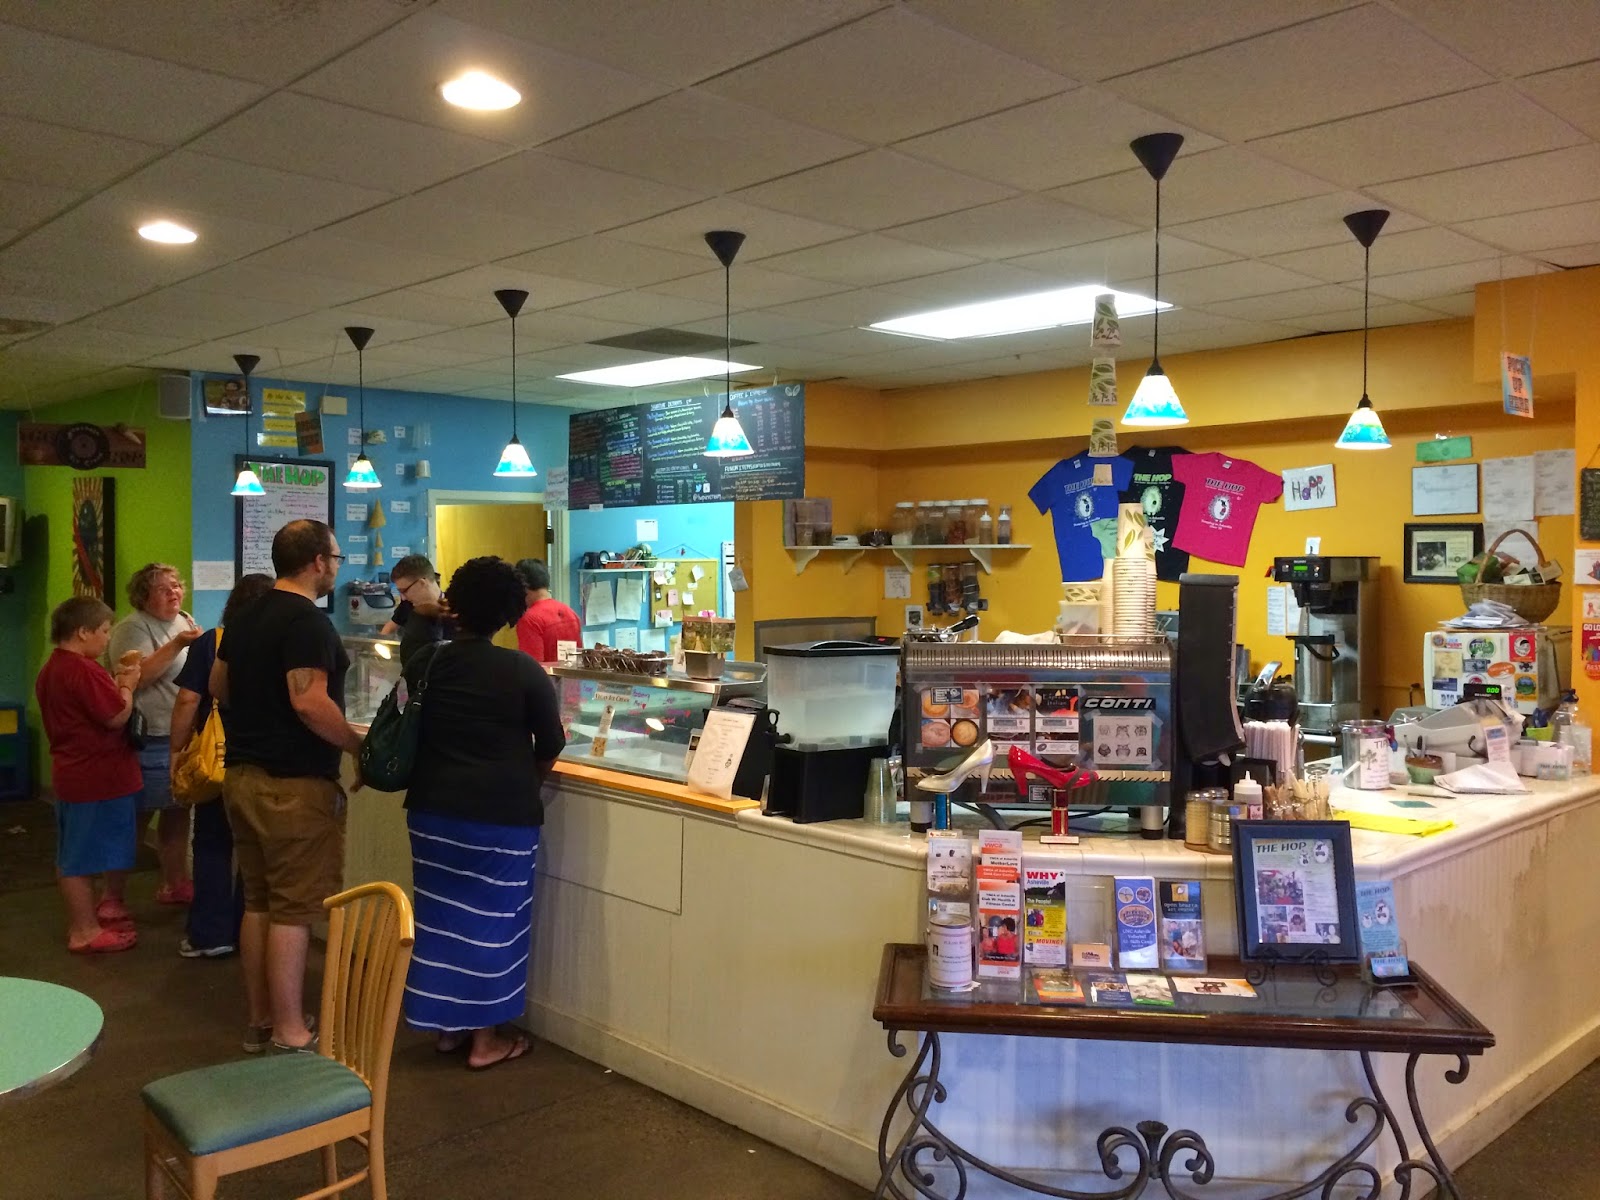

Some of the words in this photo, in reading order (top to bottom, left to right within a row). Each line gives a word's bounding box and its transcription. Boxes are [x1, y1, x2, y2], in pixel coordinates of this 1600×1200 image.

[285, 466, 327, 487] HOP
[1133, 473, 1151, 482] THE
[1152, 473, 1173, 482] HOP
[1205, 477, 1224, 489] THE
[1223, 482, 1246, 493] HOP
[1583, 623, 1593, 631] GO
[1084, 698, 1152, 709] CONTI
[1256, 843, 1278, 853] THE
[1281, 841, 1307, 851] HOP
[1026, 871, 1058, 880] WHY
[1374, 886, 1391, 895] HOP
